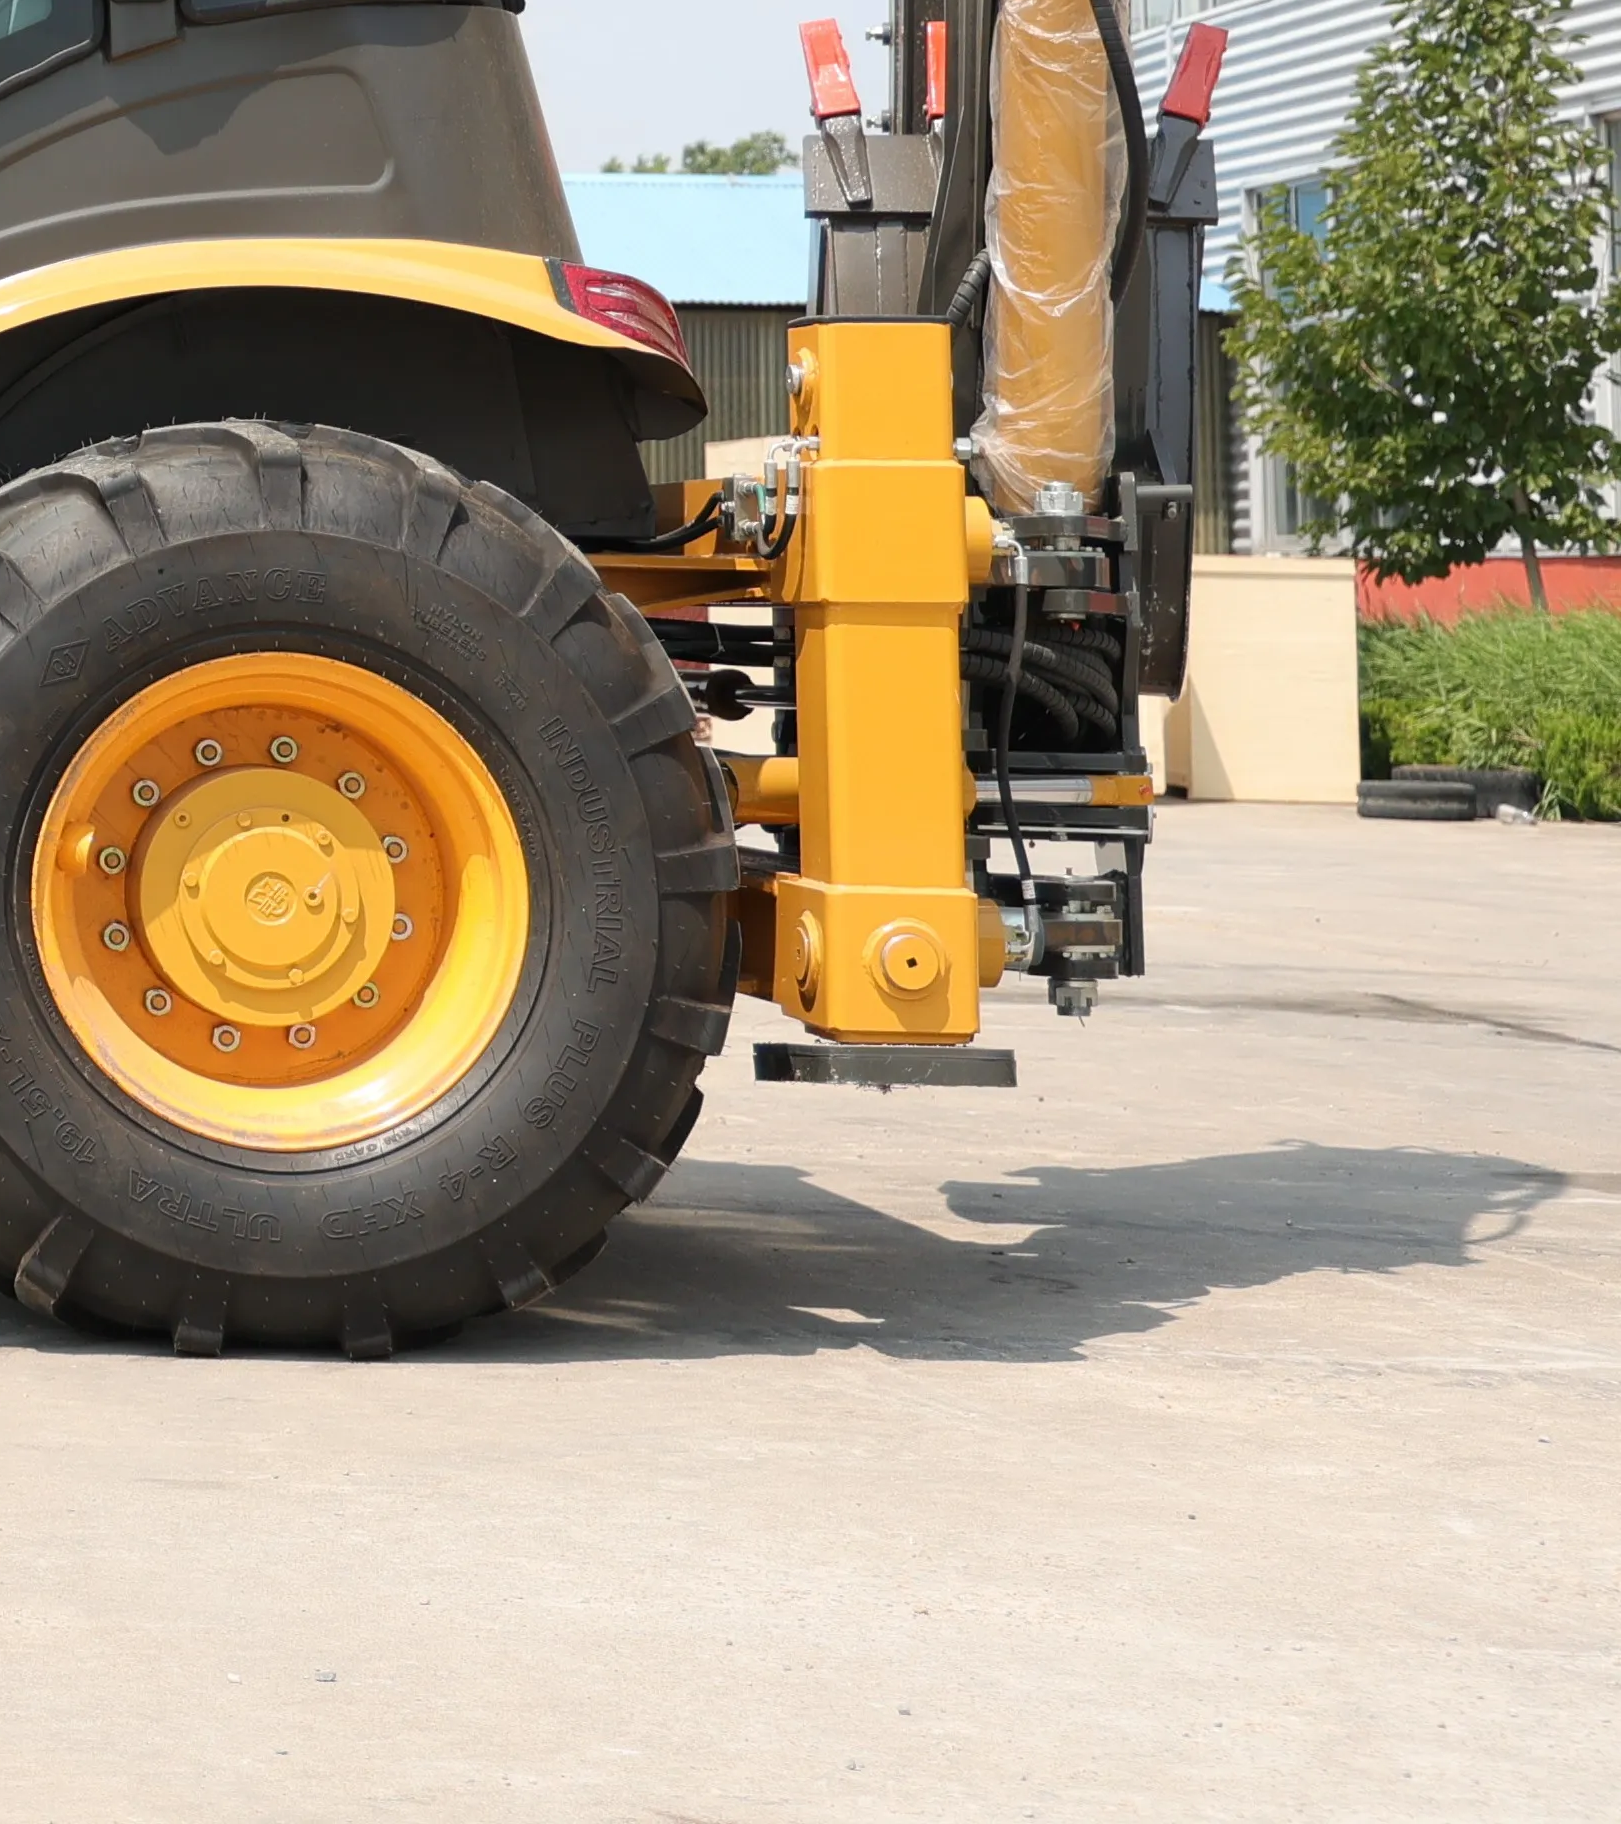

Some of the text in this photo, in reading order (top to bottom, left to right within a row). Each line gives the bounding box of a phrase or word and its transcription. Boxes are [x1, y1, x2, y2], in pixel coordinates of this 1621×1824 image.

[101, 567, 328, 653] ADVANCE
[411, 605, 488, 662] TUBELESS
[429, 602, 485, 641] NYLON
[537, 716, 625, 994] INDUSTRIAL
[521, 1018, 603, 1130] PLUS
[437, 1132, 519, 1202] R-4
[125, 1167, 283, 1245] ULTRA
[318, 1189, 425, 1242] XHD
